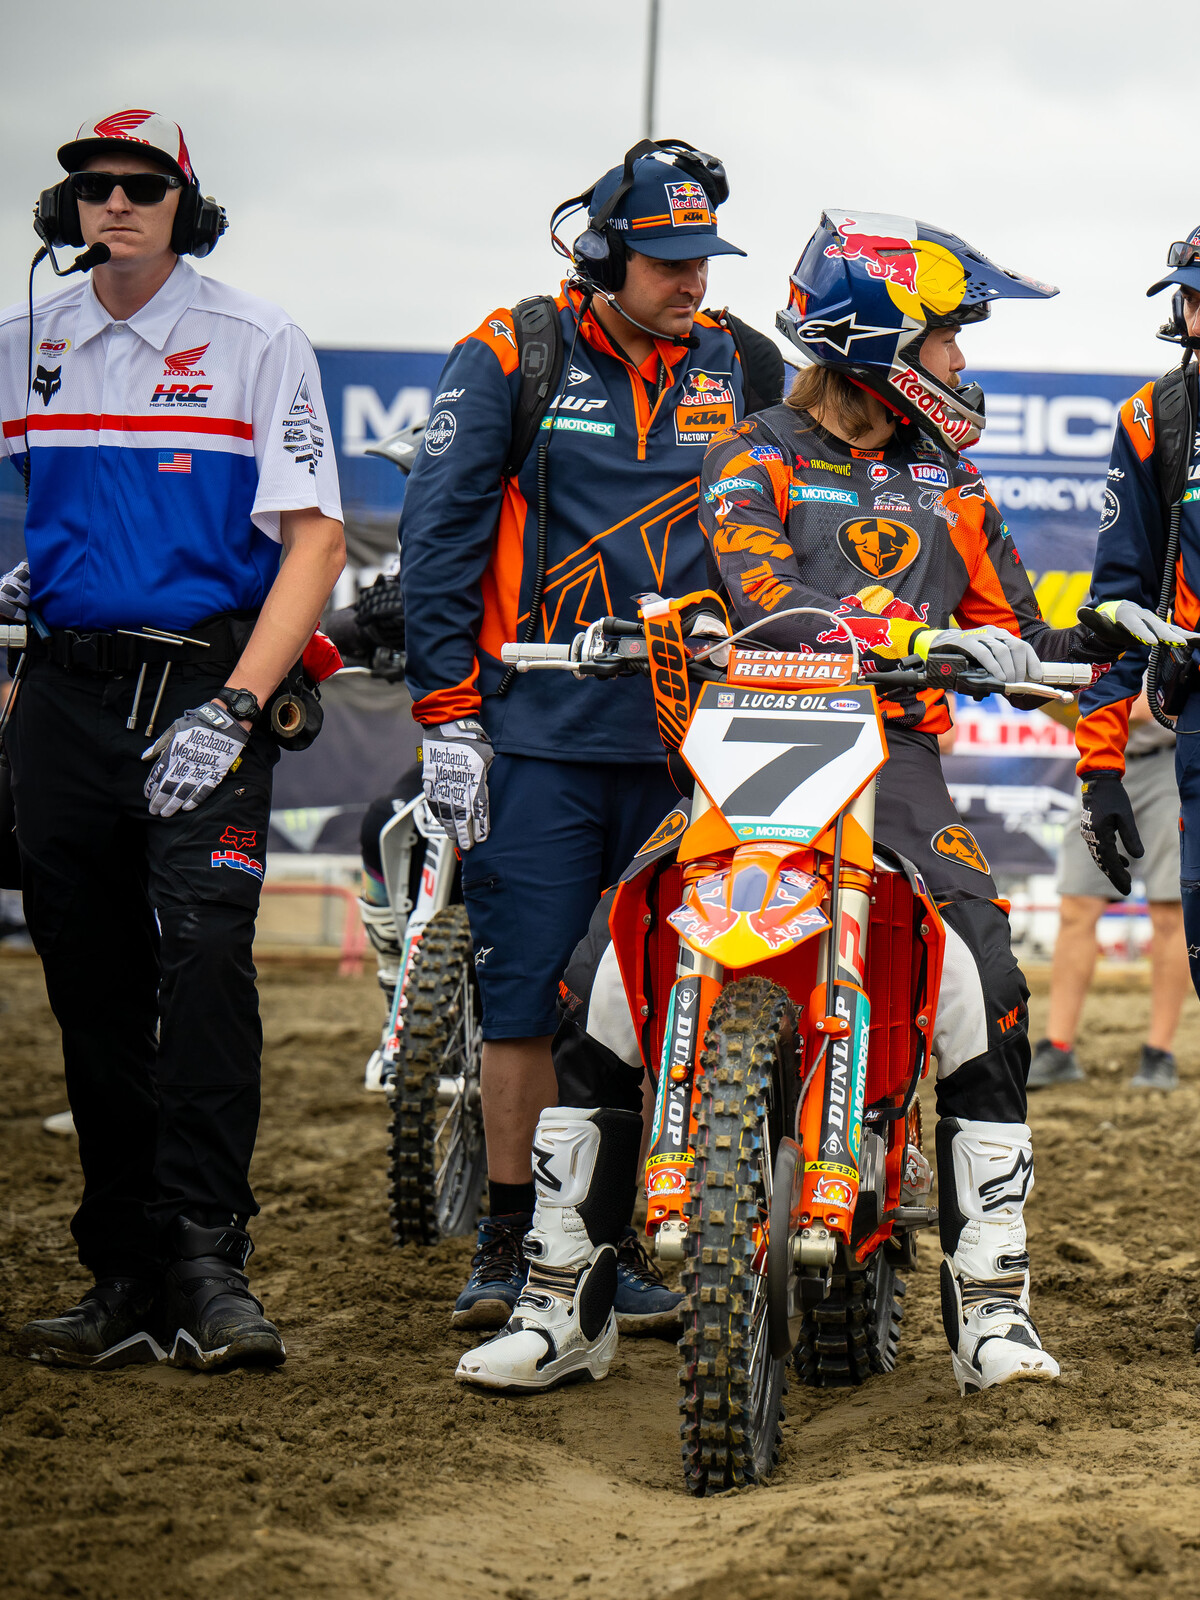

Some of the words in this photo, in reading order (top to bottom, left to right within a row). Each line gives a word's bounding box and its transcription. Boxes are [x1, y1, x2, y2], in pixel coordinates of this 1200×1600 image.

[671, 198, 691, 209] Red
[692, 197, 708, 209] Bull
[607, 218, 629, 230] CING
[683, 212, 703, 221] KTM
[163, 369, 207, 377] HONDA
[150, 384, 214, 403] HRC
[702, 388, 733, 405] Bull
[557, 418, 614, 435] MOTOREX
[685, 411, 727, 426] KTM
[680, 433, 709, 442] FACTORY
[857, 451, 880, 459] THOR
[916, 466, 946, 483] 100%
[802, 488, 854, 504] MOTOREX
[959, 628, 988, 639] THOR
[733, 663, 849, 680] RENTHAL
[648, 619, 691, 749] 100%
[740, 693, 798, 709] LUCAS
[800, 695, 828, 711] OIL
[186, 728, 234, 755] Mechanix
[172, 741, 220, 766] Mechanix
[429, 746, 472, 769] Mechanix
[434, 764, 479, 786] Mechanix
[721, 716, 866, 817] 7
[755, 825, 811, 839] MOTOREX
[210, 850, 264, 881] HRC
[828, 995, 852, 1131] DUNLP
[853, 1018, 871, 1121] MOTOREX
[807, 1162, 857, 1179] ACERBIS
